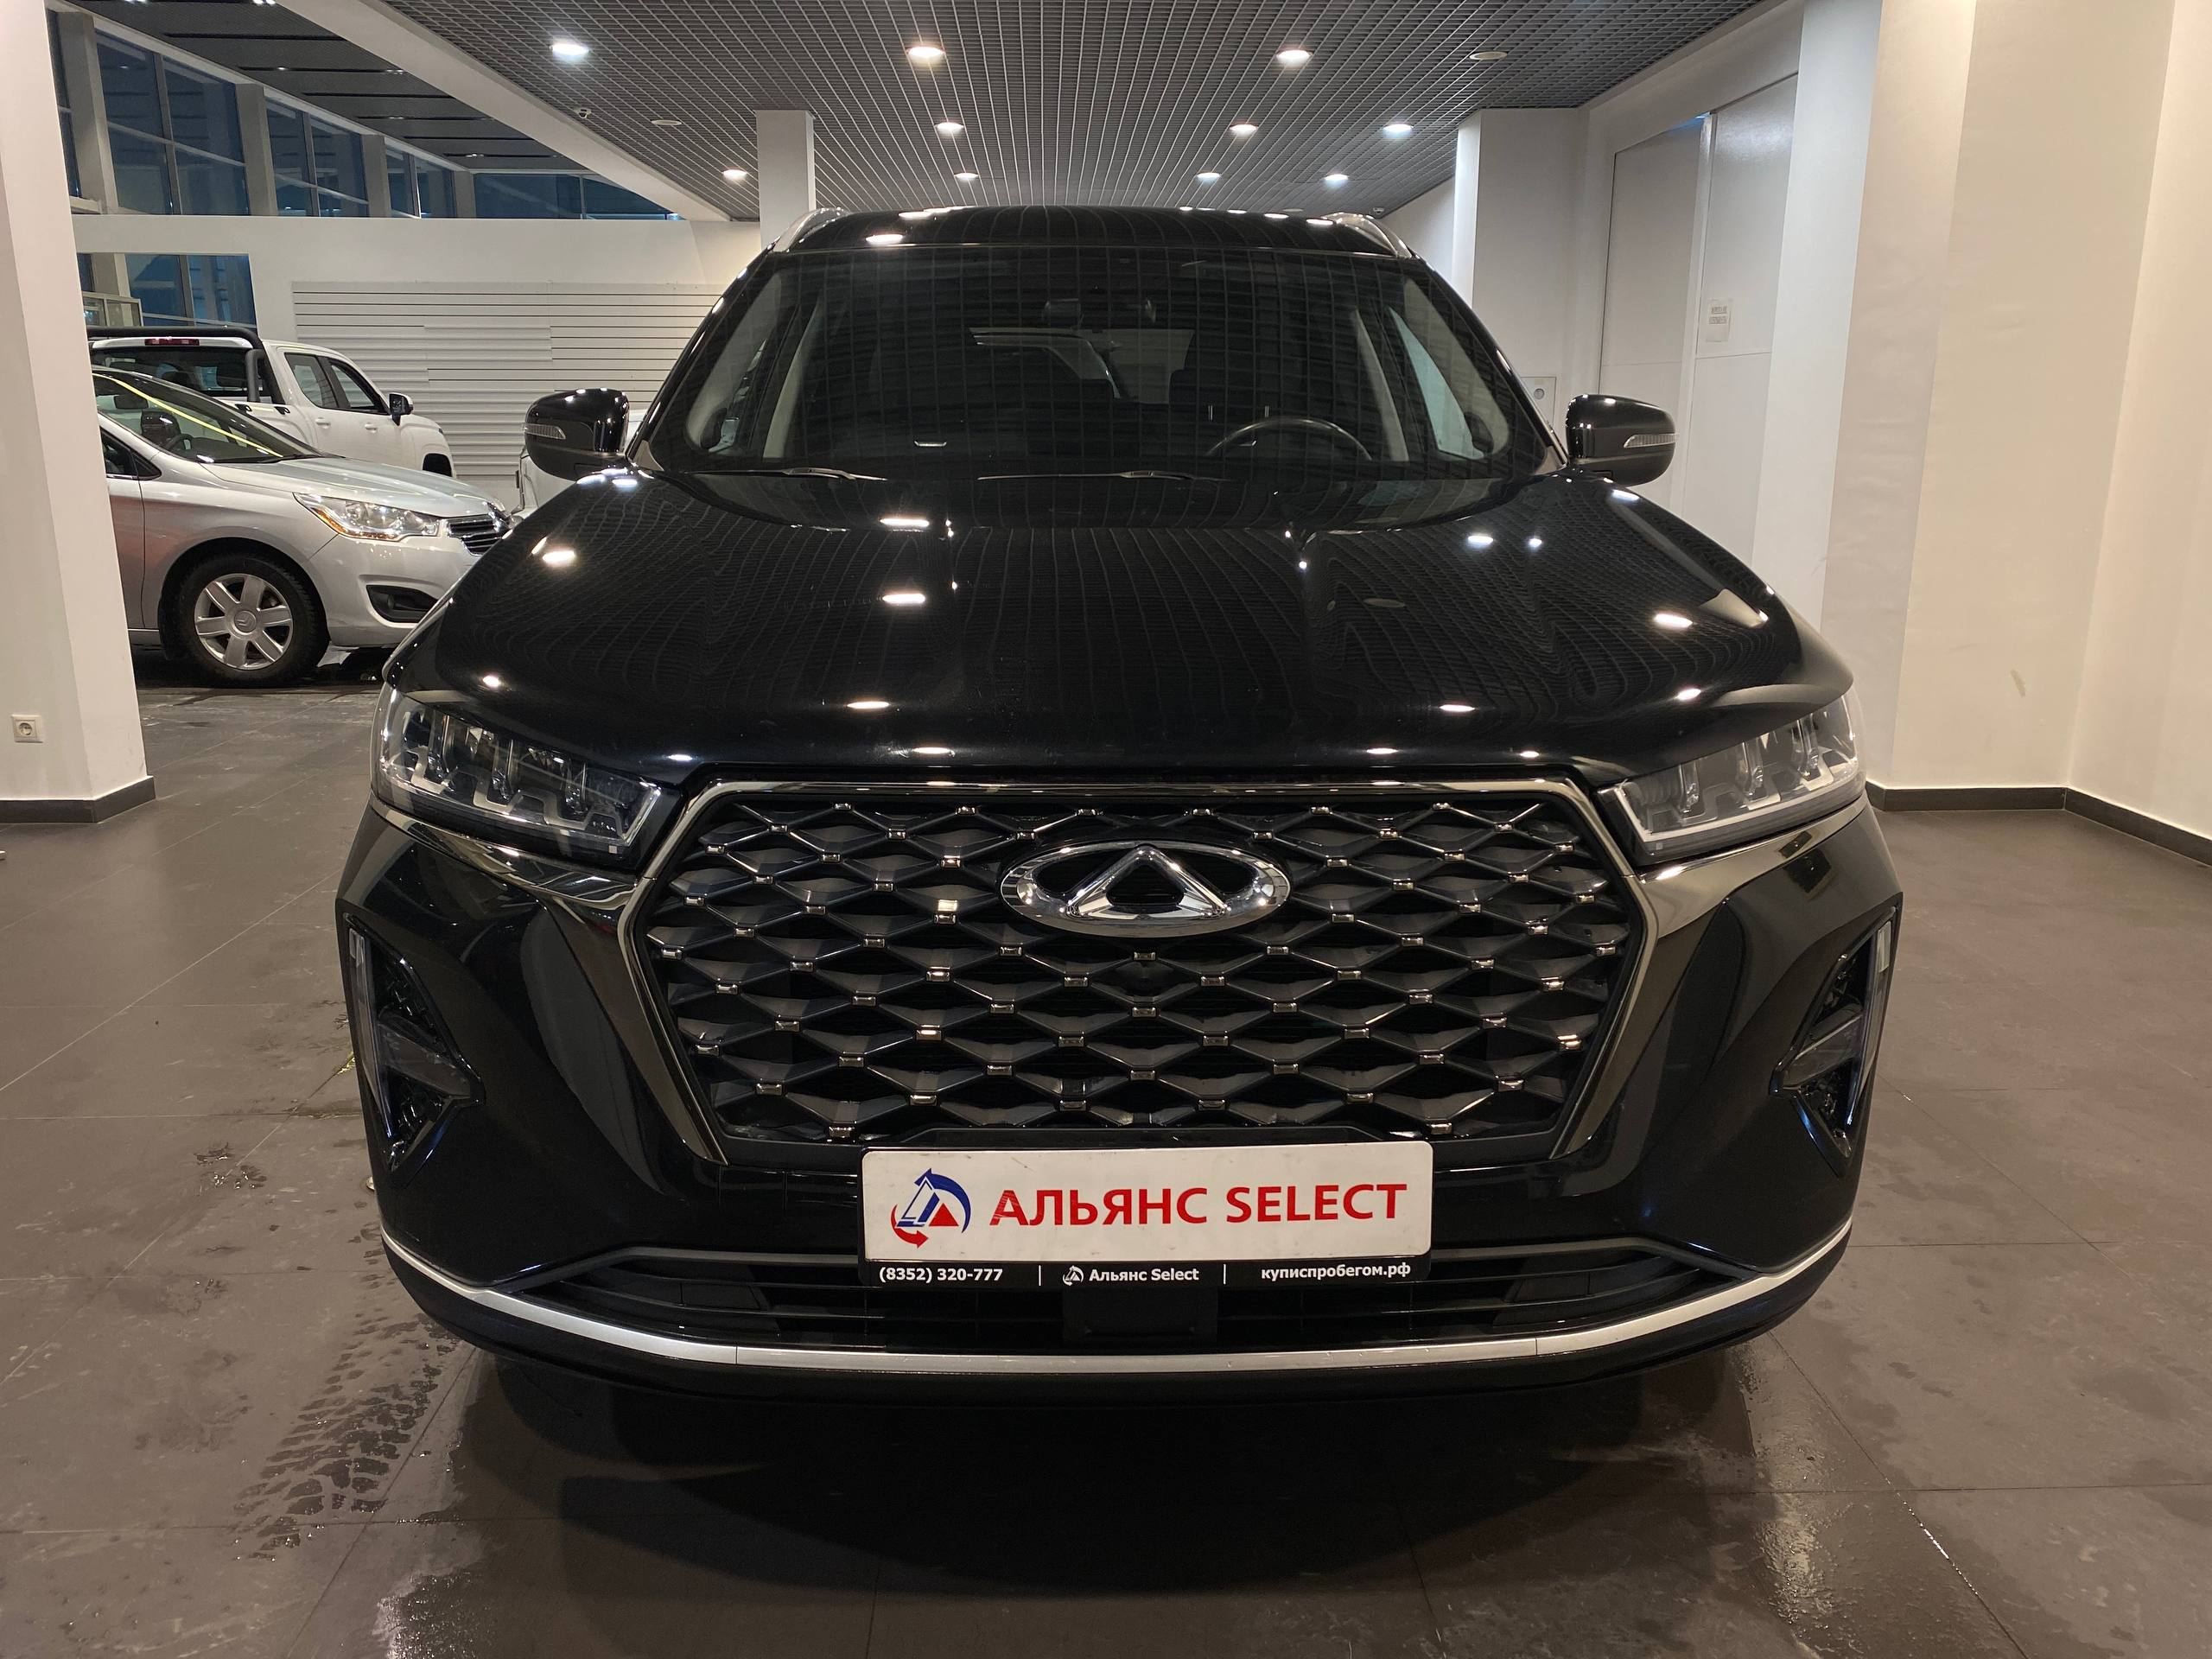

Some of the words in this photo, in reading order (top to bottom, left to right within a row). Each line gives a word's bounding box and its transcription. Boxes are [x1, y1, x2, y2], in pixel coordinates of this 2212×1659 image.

[989, 1187, 1208, 1226] АЛЬЯНС
[1225, 1183, 1408, 1223] SELECT
[879, 1267, 933, 1284] (8352)
[937, 1268, 1003, 1281] 320-777
[1089, 1268, 1147, 1281] Альянс
[1151, 1268, 1199, 1281] Select
[1261, 1262, 1412, 1282] куписпробегом.рф
